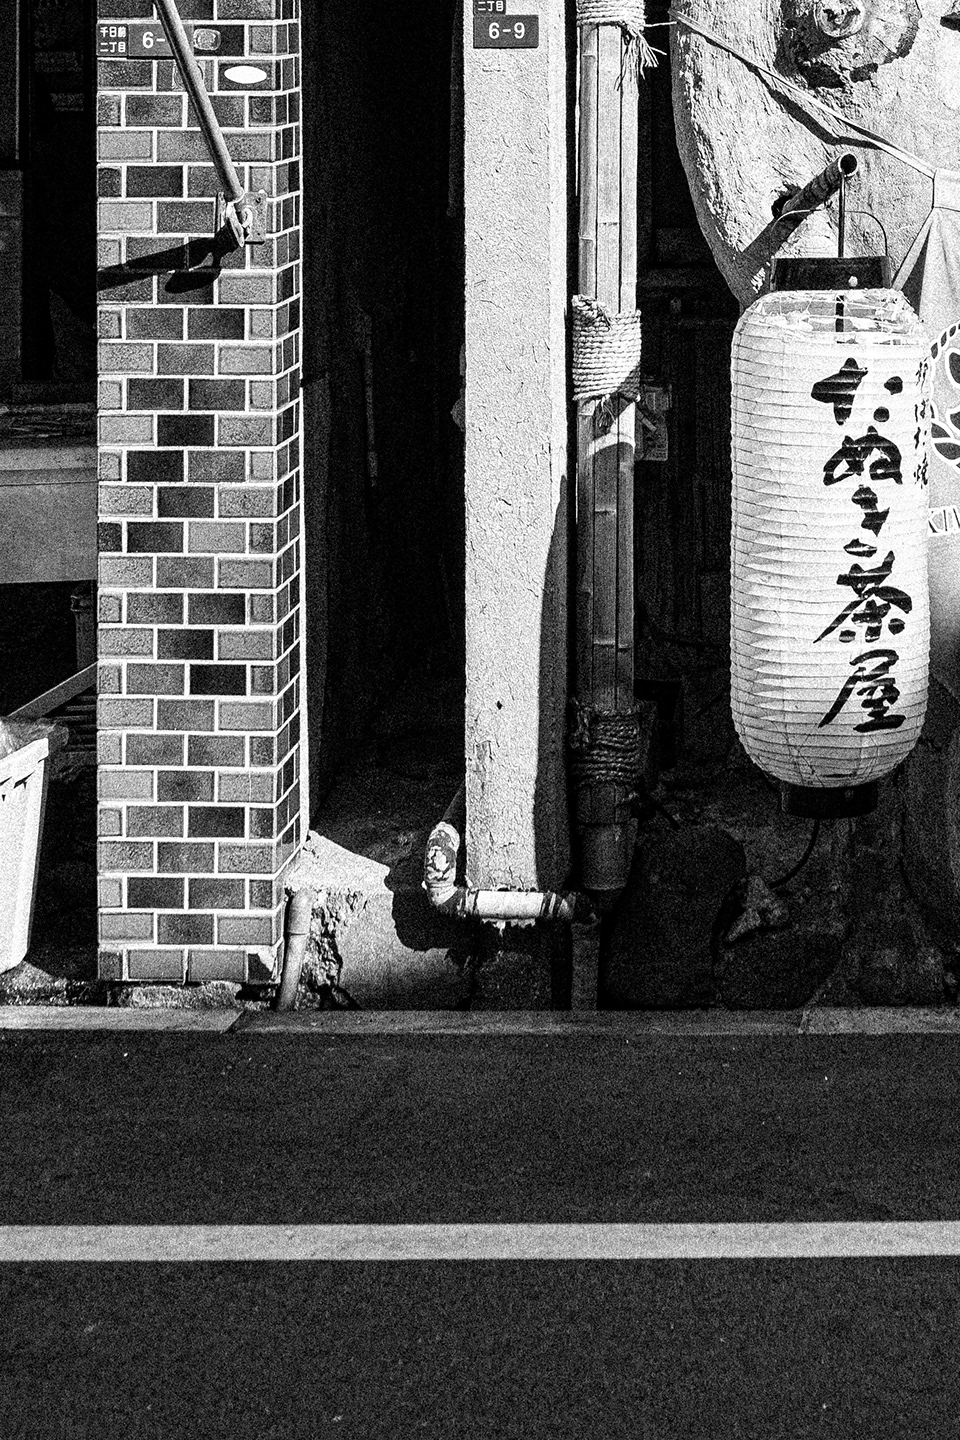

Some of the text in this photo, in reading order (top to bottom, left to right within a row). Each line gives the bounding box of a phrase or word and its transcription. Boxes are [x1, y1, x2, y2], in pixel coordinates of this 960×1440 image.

[477, 0, 504, 12] 二丁目
[99, 26, 127, 38] 千日前
[488, 21, 526, 40] 6-9
[142, 31, 167, 49] 6-
[99, 41, 126, 53] 二丁目
